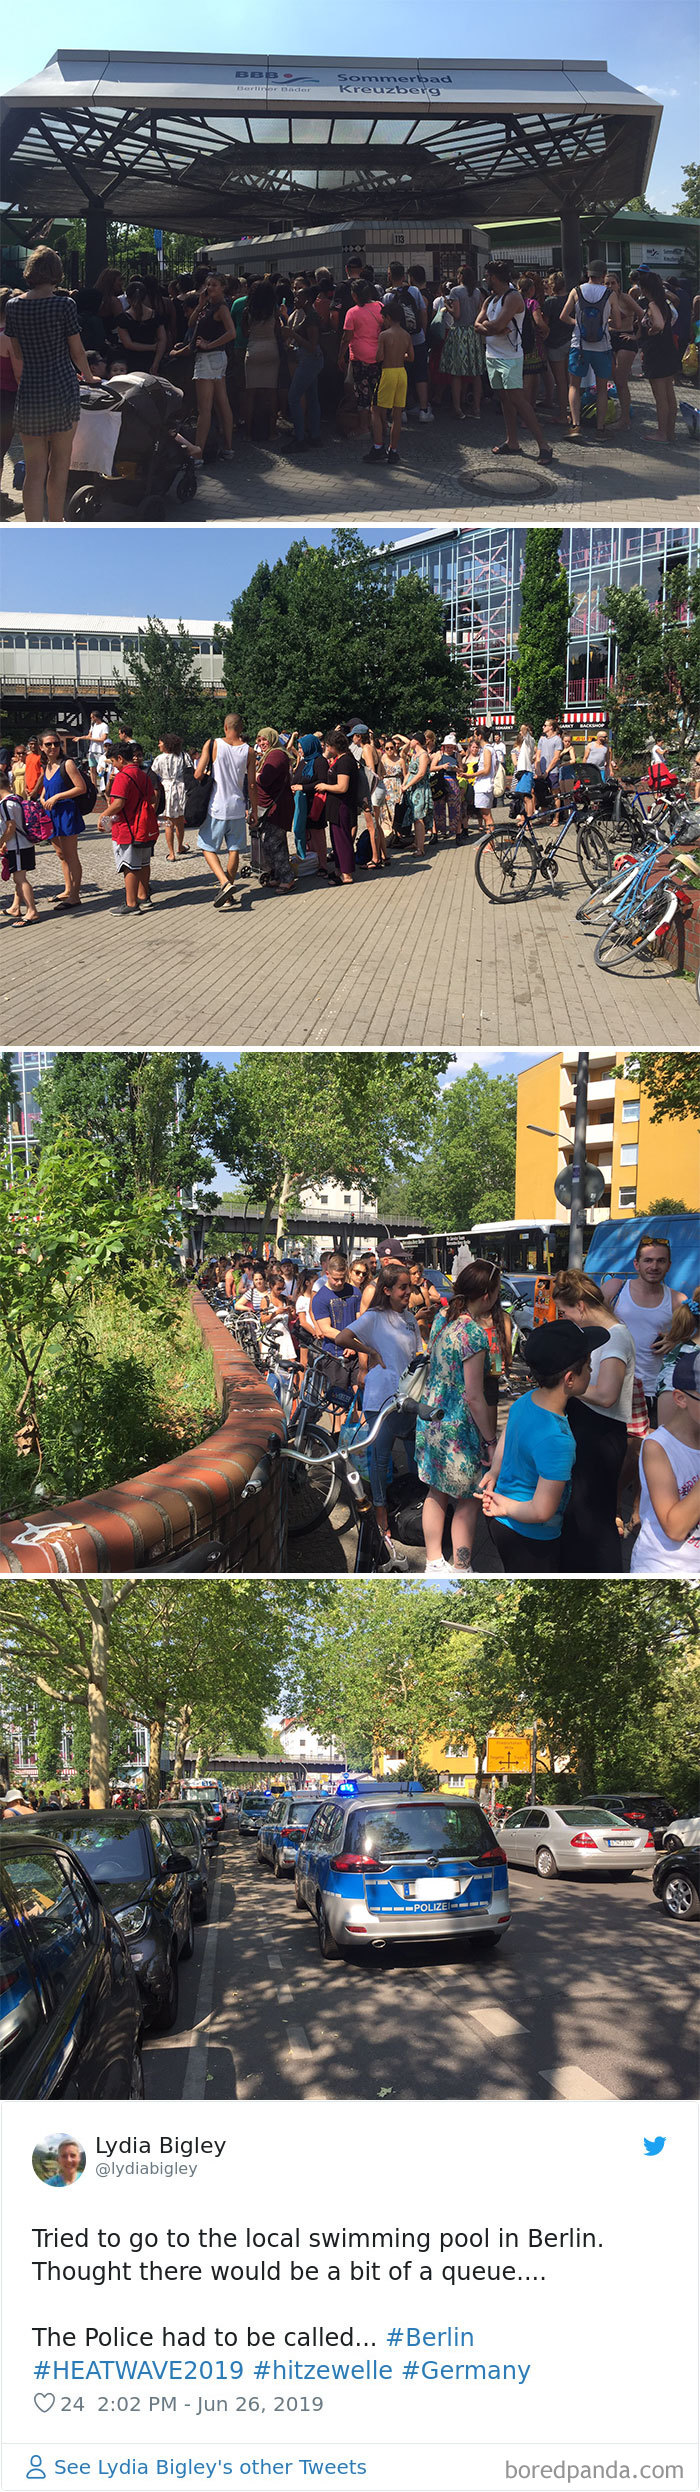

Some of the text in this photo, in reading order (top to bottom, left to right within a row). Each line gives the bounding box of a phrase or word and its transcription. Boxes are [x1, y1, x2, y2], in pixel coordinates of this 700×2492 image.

[235, 71, 279, 79] BBB
[337, 73, 453, 84] Sommerbad
[339, 85, 441, 97] Kreuzberg
[414, 1902, 451, 1912] POLIZEI
